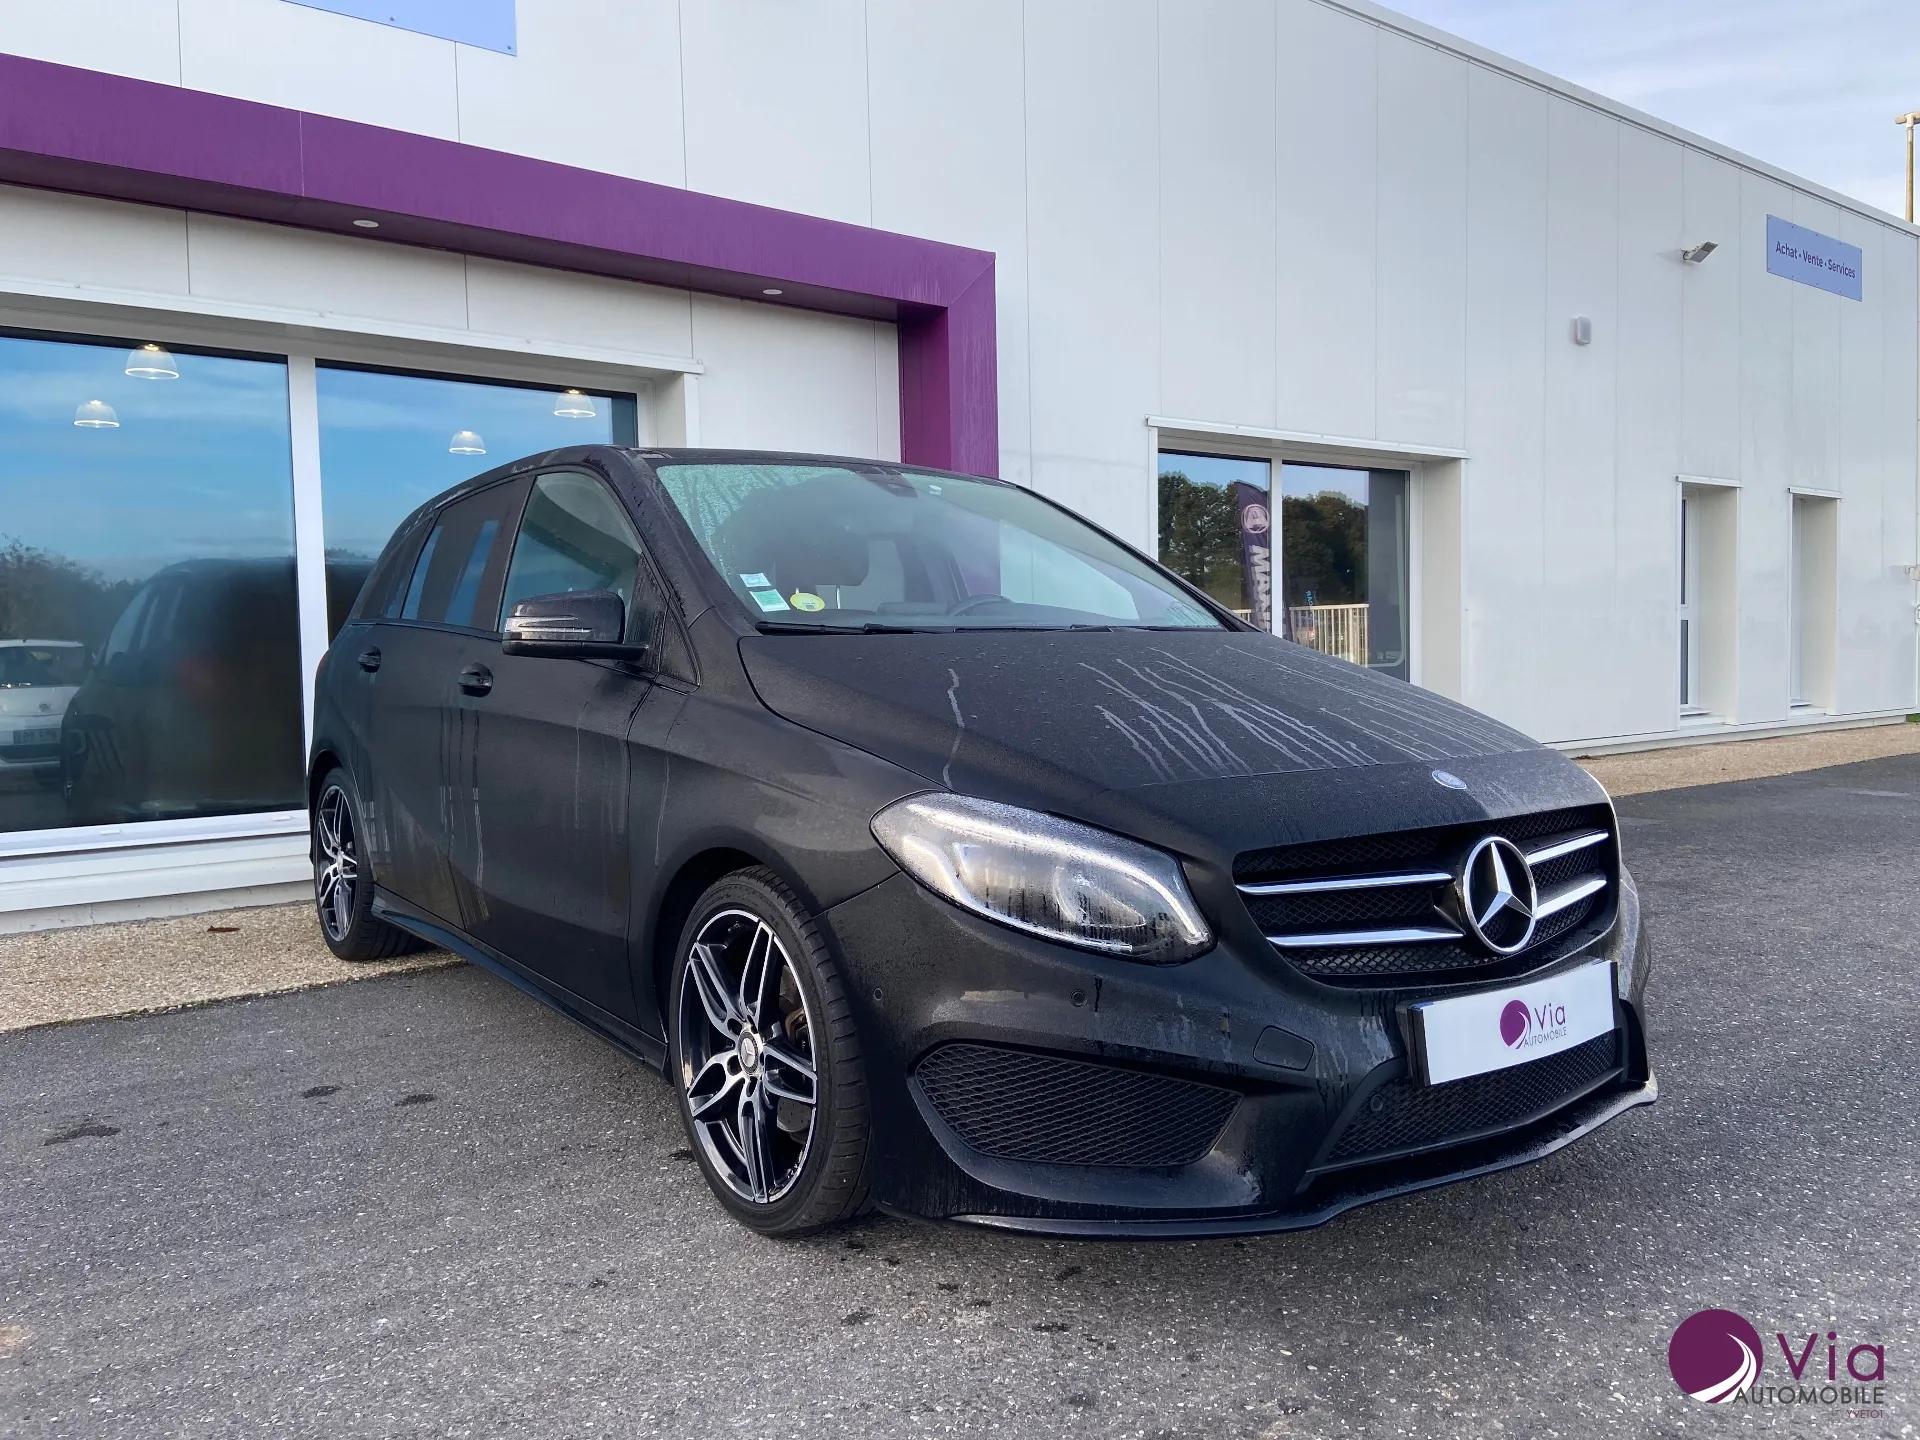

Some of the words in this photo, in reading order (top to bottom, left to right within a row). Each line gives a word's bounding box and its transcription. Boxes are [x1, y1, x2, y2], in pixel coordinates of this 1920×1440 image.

[1775, 241, 1798, 260] Achat
[1802, 249, 1824, 268] Vente
[1827, 258, 1856, 279] Services
[1534, 1002, 1566, 1031] Via
[1523, 1027, 1568, 1048] AUTOMOBILE
